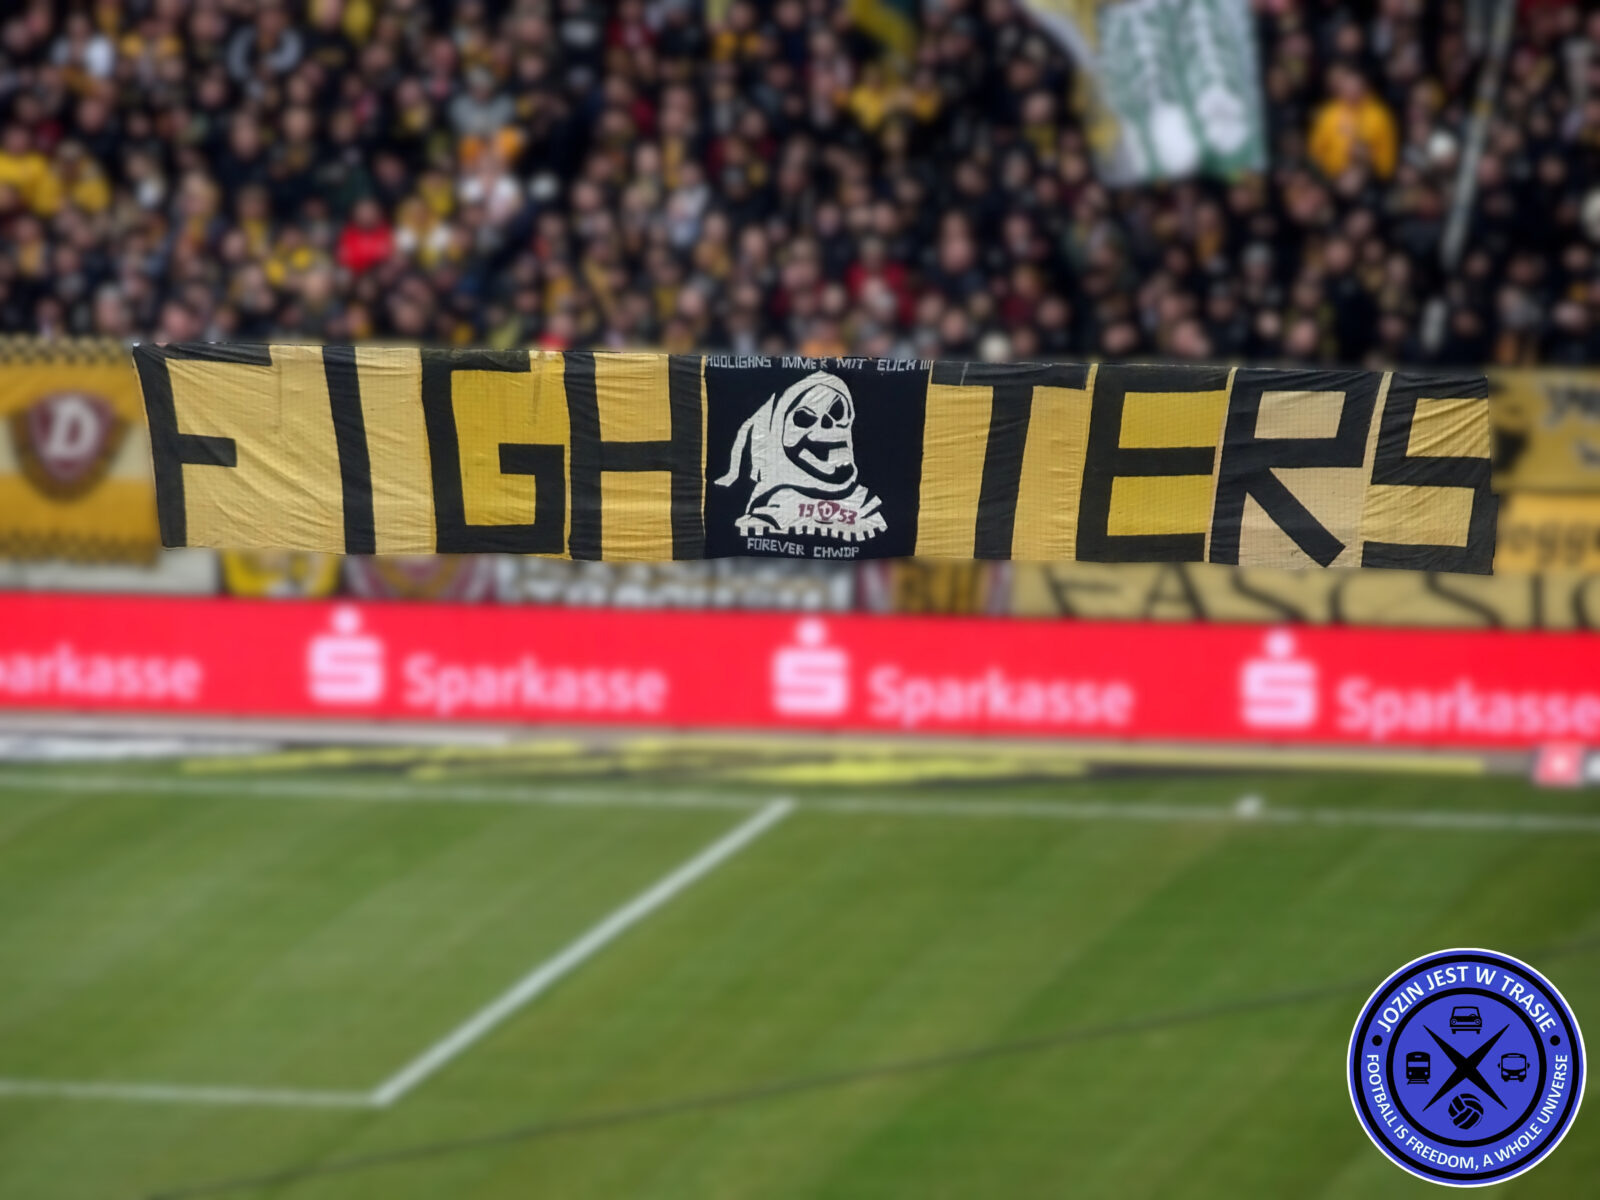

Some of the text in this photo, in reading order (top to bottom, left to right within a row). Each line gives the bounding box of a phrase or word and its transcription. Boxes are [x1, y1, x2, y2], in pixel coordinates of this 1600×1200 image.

[782, 356, 829, 369] IMMER
[836, 358, 866, 369] MIT
[747, 538, 860, 558] FOREVER CHWDP
[404, 653, 668, 715] Sparkasse
[868, 665, 1134, 728] Sparkasse
[1336, 677, 1600, 740] Sparkasse
